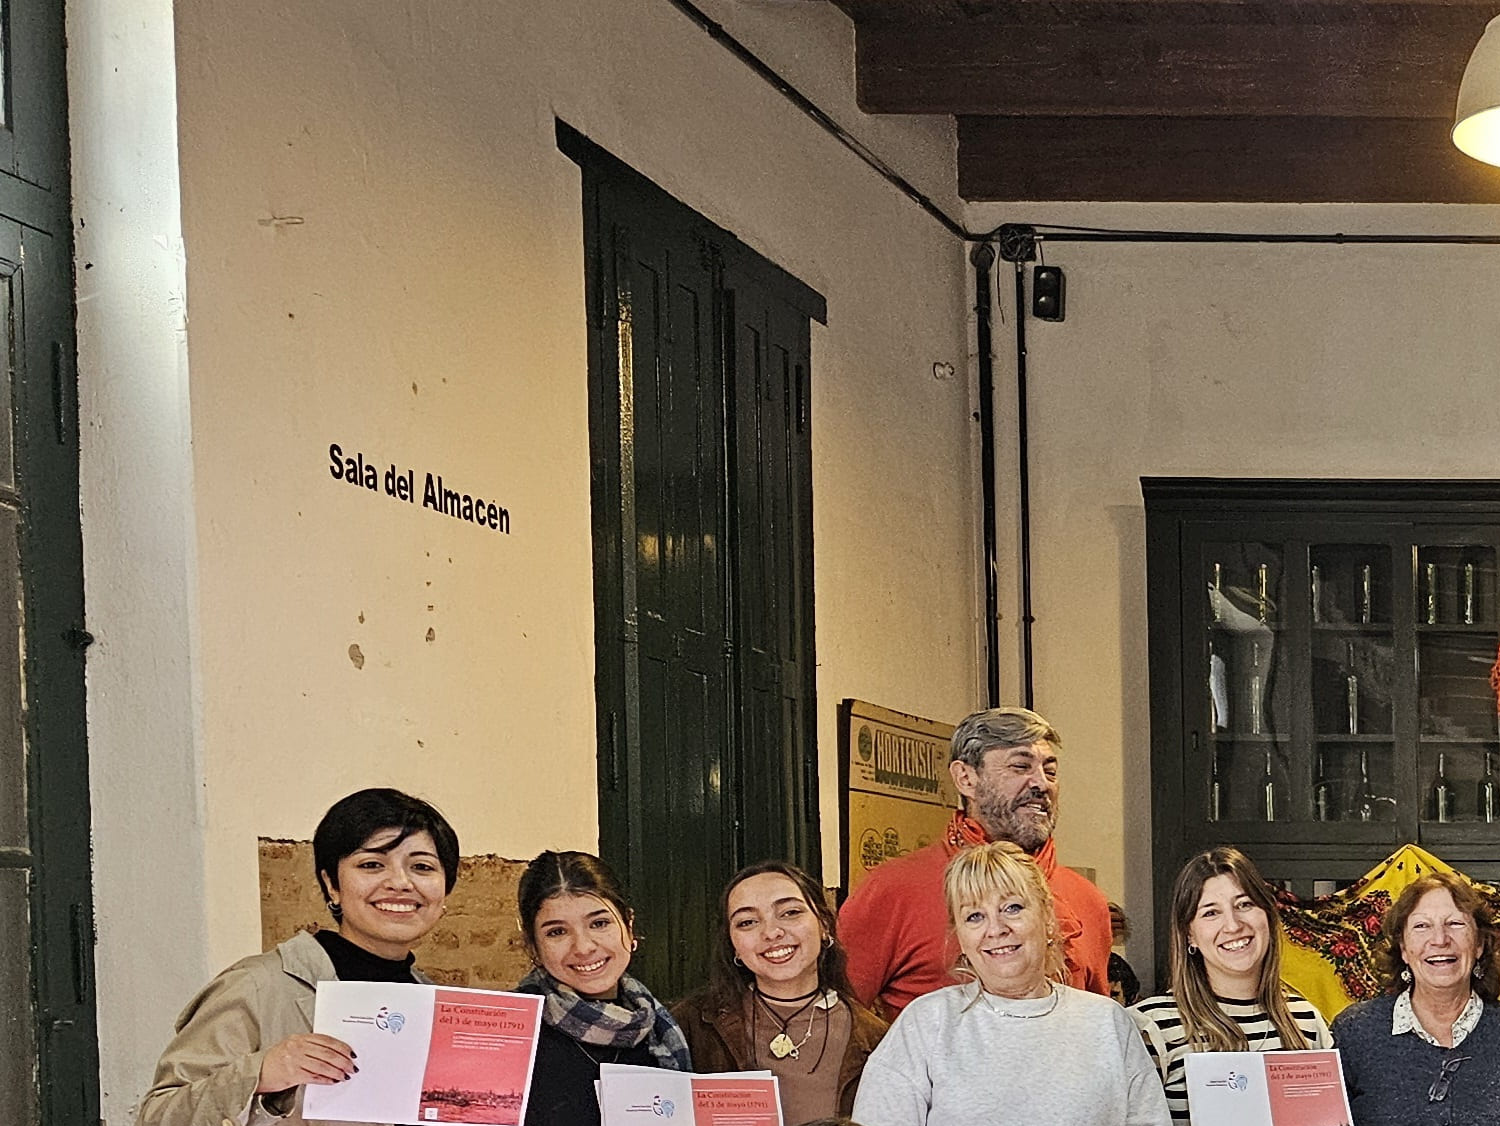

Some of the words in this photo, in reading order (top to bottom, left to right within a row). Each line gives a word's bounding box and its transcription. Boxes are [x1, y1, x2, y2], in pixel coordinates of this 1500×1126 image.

[329, 443, 378, 491] Sala
[384, 463, 414, 503] del
[440, 1005, 451, 1013] La
[439, 1016, 453, 1024] del
[462, 1017, 471, 1026] de
[474, 1020, 498, 1029] mayo
[499, 1021, 525, 1030] (1791)
